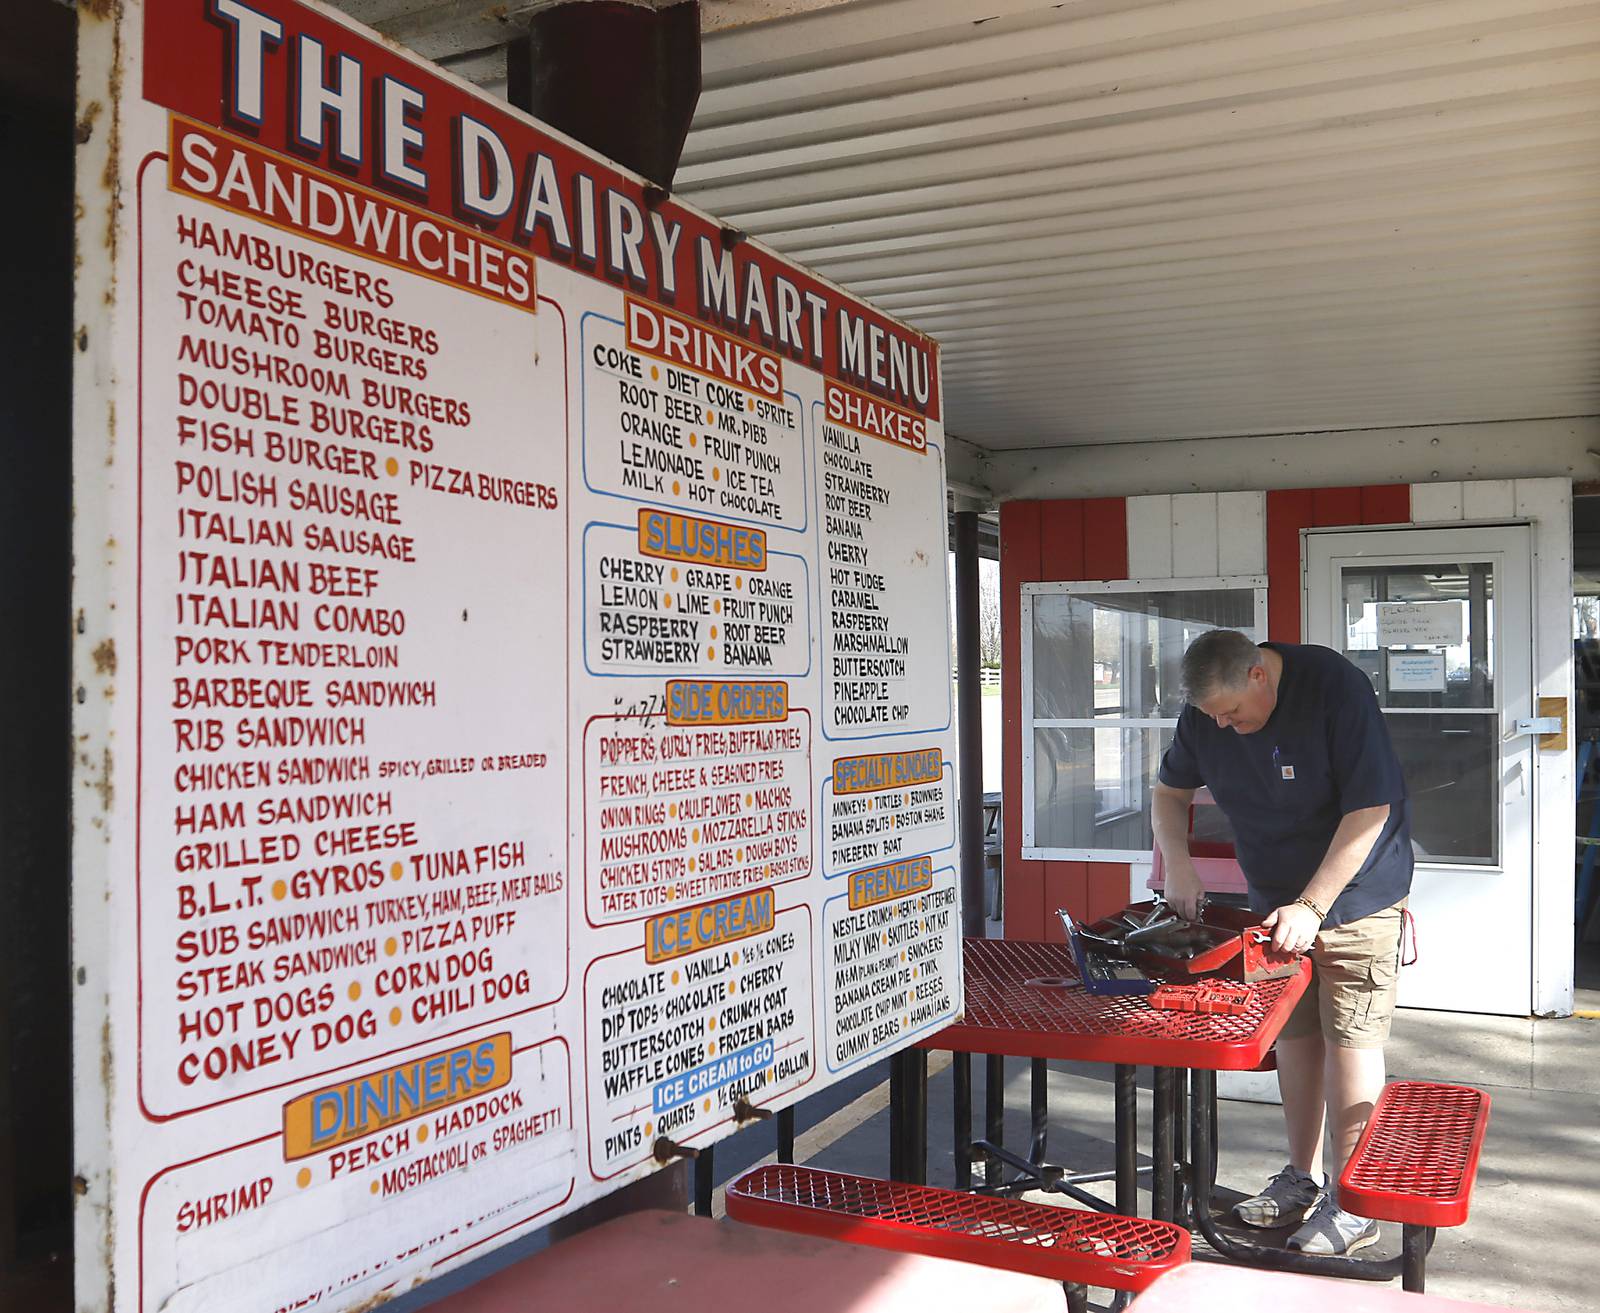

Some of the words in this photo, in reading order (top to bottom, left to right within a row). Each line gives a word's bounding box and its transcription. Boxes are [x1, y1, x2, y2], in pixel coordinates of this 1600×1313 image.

[180, 132, 530, 303] SANDWICHES
[214, 0, 429, 190] THE
[459, 113, 684, 295] DAIRY
[699, 234, 829, 358] MART
[838, 307, 931, 406] MENU
[177, 214, 393, 308] HAMBURGERS
[177, 260, 307, 319] CHEESE
[324, 301, 439, 355] BURGERS
[178, 292, 299, 348] TOMATO
[314, 330, 427, 380] BURGERS
[629, 302, 779, 394] DRINKS
[179, 335, 350, 399] MUSHROOM
[362, 379, 470, 426] BURGERS
[594, 344, 642, 378] COKE
[667, 368, 699, 397] DIET
[707, 383, 744, 412] COKE
[757, 400, 795, 428] SPRITE
[179, 374, 299, 425] DOUBLE
[310, 402, 434, 453] BURGERS
[829, 388, 925, 448] SHAKES
[621, 412, 683, 449] ORANGE
[704, 435, 741, 463] FRUIT
[746, 447, 781, 474] PUNCH
[823, 425, 860, 454] VANILLA
[824, 451, 872, 478] CHOCOLATE
[176, 461, 277, 507] POLISH
[289, 479, 401, 524] SAUSAGE
[621, 440, 704, 480] LEMONADE
[726, 469, 746, 491] ICE
[751, 475, 775, 497] TEA
[622, 468, 664, 493] MILK
[689, 483, 715, 504] HOT
[721, 492, 782, 520] CHOCOLATE
[825, 472, 890, 504] STRAWBERRY
[825, 494, 845, 512] ROOT
[849, 499, 871, 520] BEER
[826, 516, 863, 540] BANANA
[178, 508, 292, 547] ITALIAN
[305, 525, 415, 562] SAUSAGE
[647, 514, 763, 566] SLUSHES
[828, 541, 867, 566] CHERRY
[179, 552, 299, 592] ITALIAN
[309, 563, 378, 597] BEEF
[600, 557, 664, 585] CHERRY
[686, 569, 732, 591] GRAPE
[749, 577, 792, 599] ORANGE
[831, 568, 849, 585] HOT
[854, 571, 885, 591] FUDGE
[832, 590, 879, 610] CARAMEL
[177, 594, 298, 630] ITALIAN
[315, 604, 404, 635] COMBO
[600, 613, 698, 640] RASPBERRY
[724, 623, 750, 643] ROOT
[754, 626, 785, 645] BEER
[601, 584, 658, 610] LEMON
[677, 593, 710, 615] LIME
[723, 598, 754, 620] FRUIT
[759, 603, 792, 624] PUNCH
[832, 611, 889, 631] RASPBERRY
[176, 636, 250, 665] PORK
[258, 641, 398, 668] TENDERLOIN
[601, 639, 699, 663] STRAWBERRY
[724, 644, 772, 666] BANANA
[833, 658, 905, 677] BUTTERSCOTCH
[834, 633, 908, 654] MARSHMALLOW
[173, 678, 312, 708] BARBEQUE
[326, 681, 436, 707] SANDWICH
[670, 683, 713, 720] SIDE
[719, 684, 784, 719] ORDERS
[834, 682, 888, 701] PINEAPPLE
[835, 706, 888, 725] CHOCOLATE
[892, 705, 909, 720] CHIP
[173, 720, 224, 751] RIB
[237, 718, 364, 749] SANDWICH
[837, 757, 892, 791] SPECIALTY
[896, 752, 939, 782] SUNDAES
[176, 802, 245, 835] HAM
[258, 792, 391, 825] SANDWICH
[601, 806, 632, 829] ONION
[635, 802, 665, 825] RINGS
[679, 793, 741, 820] CAULIFLOWER
[755, 787, 791, 811] NACHOS
[832, 820, 864, 841] BANANA
[866, 816, 890, 834] SPLITS
[896, 811, 922, 828] BOSTON
[925, 807, 945, 823] SHAKE
[176, 835, 299, 871] GRILLED
[315, 822, 418, 856] CHEESE
[601, 827, 687, 860] MUSHROOMS
[702, 814, 773, 844] MOZZARELLA
[777, 809, 807, 830] STICKS
[832, 843, 878, 866] PINEBERRY
[883, 838, 902, 854] BOAT
[178, 876, 262, 920] B.L.T.
[290, 860, 384, 900] GYROS
[411, 848, 469, 881] TUNA
[475, 842, 525, 873] FISH
[601, 863, 648, 889] CHICKEN
[652, 857, 685, 882] STRIPS
[700, 849, 733, 872] SALADS
[746, 842, 773, 862] DOUGH
[775, 835, 797, 857] BOYS
[854, 860, 930, 905] FRENZIES
[653, 910, 692, 955] ICE
[696, 893, 770, 944] CREAM
[834, 936, 861, 966] MILKY
[863, 932, 882, 955] WAY
[888, 920, 918, 947] SKITTLES
[925, 915, 936, 934] KIT
[938, 910, 949, 929] KAT
[177, 961, 264, 1000] STEAK
[274, 938, 377, 982] SANDWICH
[403, 920, 467, 954] PIZZA
[472, 911, 515, 949] PUFF
[602, 971, 665, 1009] CHOCOLATE
[685, 952, 731, 983] VANILLA
[179, 1002, 243, 1043] HOT
[255, 984, 334, 1026] DOGS
[375, 960, 440, 996] CORN
[446, 947, 493, 978] DOG
[602, 1013, 624, 1042] DIP
[629, 1007, 658, 1029] TOPS
[666, 981, 725, 1018] CHOCOLATE
[741, 962, 783, 993] CHERRY
[835, 984, 870, 1014] BANANA
[872, 974, 896, 999] CREAM
[900, 968, 911, 984] PIE
[920, 958, 938, 977] TWIX
[178, 1029, 301, 1085] CONEY
[314, 1009, 377, 1051] DOG
[412, 984, 474, 1024] CHILI
[484, 969, 530, 1004] DOG
[603, 1018, 704, 1073] BUTTERSCOTCH
[720, 1001, 760, 1029] CRUNCH
[764, 987, 787, 1012] COAT
[836, 1029, 870, 1062] GUMMY
[873, 1018, 899, 1045] BEARS
[605, 1059, 664, 1099] WAFFLE
[666, 1043, 704, 1072] CONES
[719, 1020, 763, 1055] FROZEN
[767, 1009, 794, 1037] BARS
[657, 1083, 684, 1108] ICE
[689, 1059, 737, 1094] CREAM
[740, 1055, 752, 1071] to
[754, 1046, 771, 1067] GO
[310, 1042, 496, 1145] DINNERS
[330, 1129, 410, 1179] PERCH
[435, 1089, 523, 1139] HADDOCK
[493, 1108, 561, 1151] SPAGHETTI
[177, 1176, 273, 1232] SHRIMP
